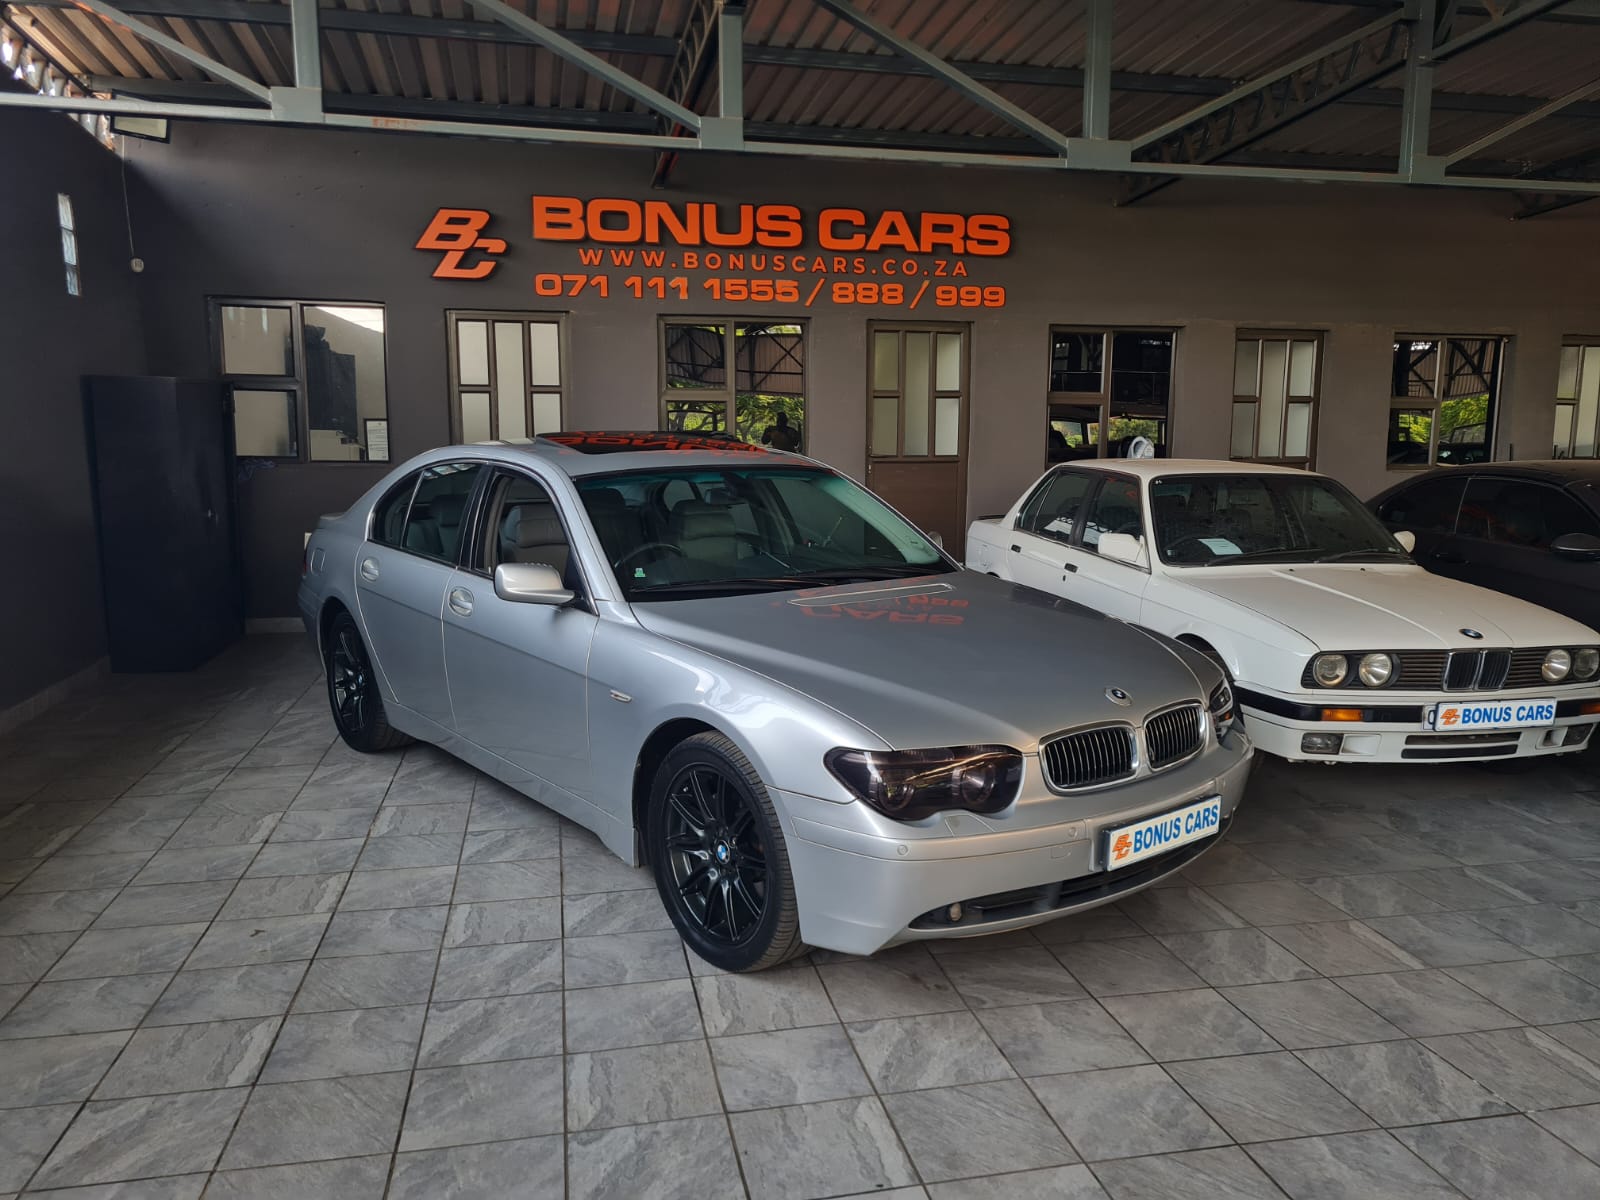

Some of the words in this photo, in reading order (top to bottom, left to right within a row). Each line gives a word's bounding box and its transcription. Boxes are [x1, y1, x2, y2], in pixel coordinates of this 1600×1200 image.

[532, 195, 803, 247] BONUS
[818, 208, 1011, 256] CARS
[579, 249, 968, 277] WWW.BONUSCARS.CO.ZA
[535, 273, 608, 297] 071
[624, 276, 689, 299] 111
[703, 279, 799, 302] 1555
[832, 282, 904, 304] 888
[936, 285, 1005, 307] 999
[1461, 707, 1512, 724] BONUS
[1516, 704, 1554, 721] CARS
[1133, 817, 1181, 853] BONUS
[1185, 804, 1218, 834] CARS
